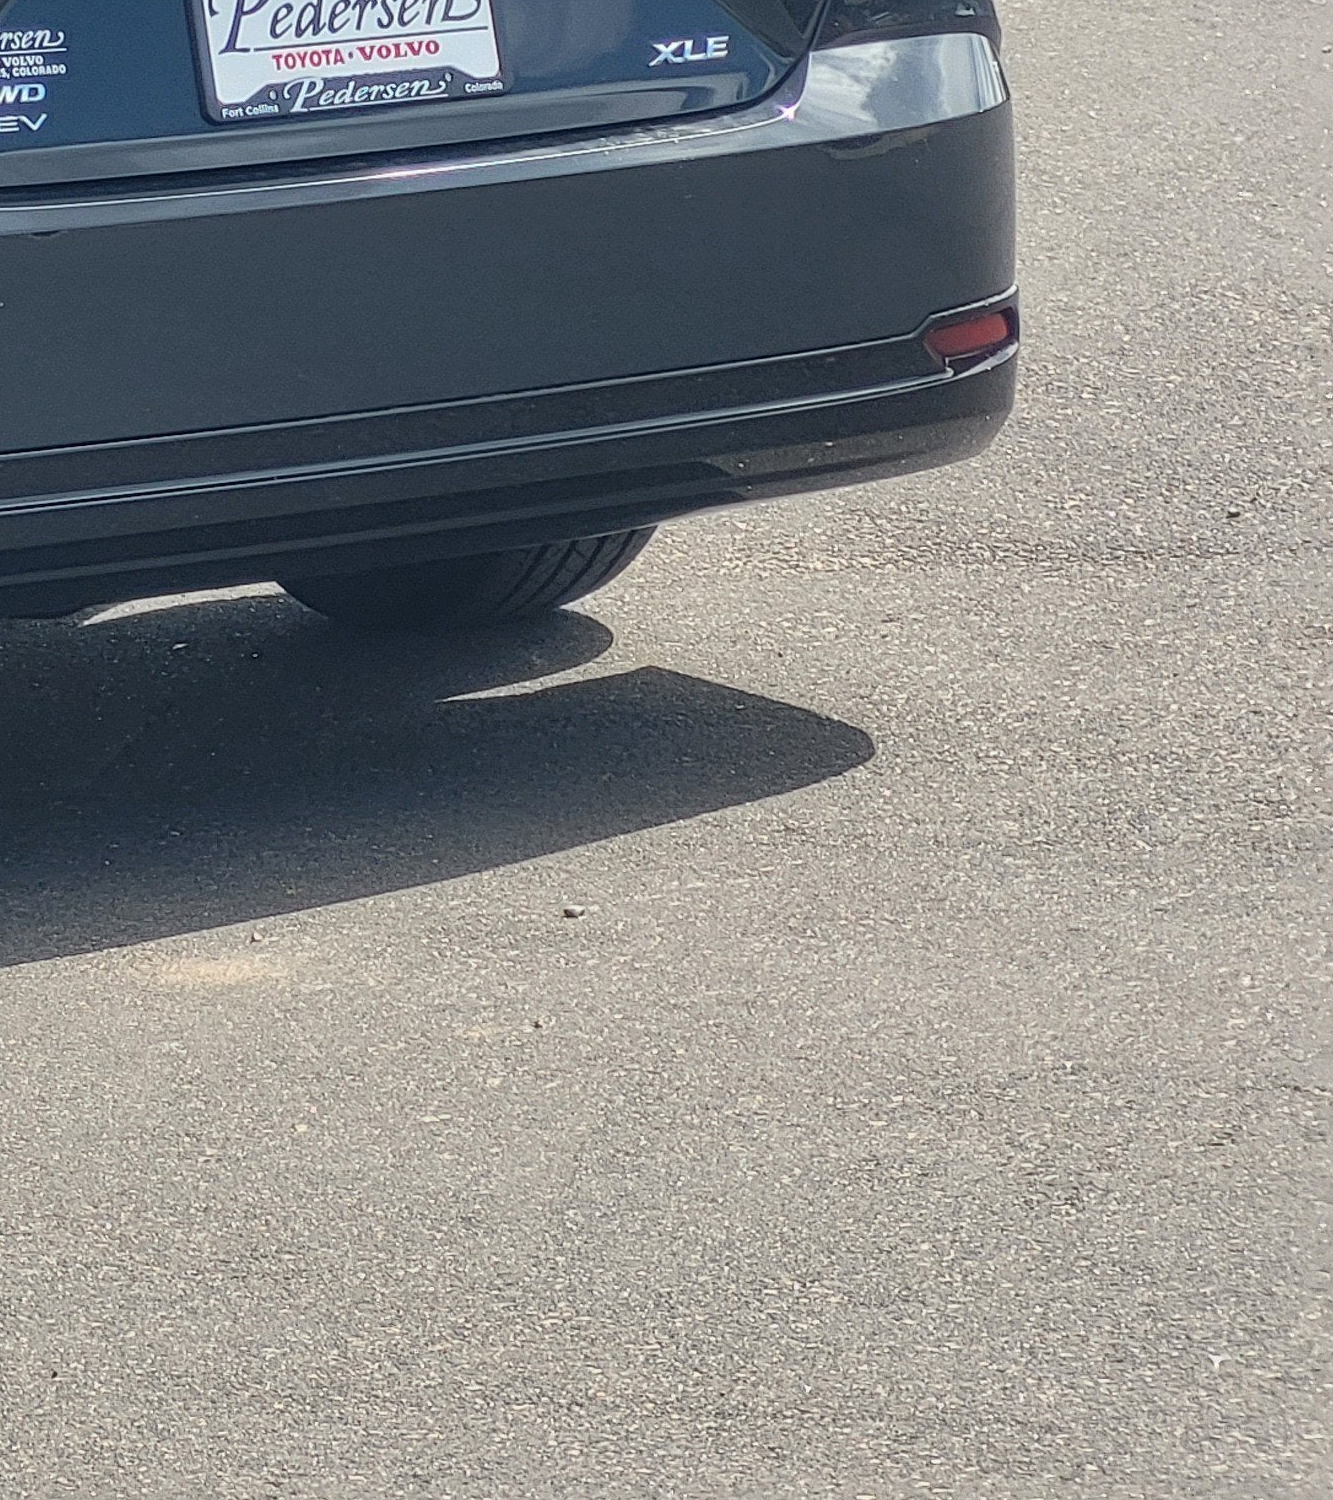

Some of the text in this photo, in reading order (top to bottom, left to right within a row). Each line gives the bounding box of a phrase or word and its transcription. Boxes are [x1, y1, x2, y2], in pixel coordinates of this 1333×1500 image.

[272, 40, 440, 71] TOYOTA VOLVO
[647, 35, 730, 67] XLE
[1, 55, 44, 68] VOLVO
[12, 64, 67, 77] COLORADO
[282, 77, 446, 113] Pedersen
[464, 81, 504, 94] Colorado
[221, 103, 280, 119] Fort Collins
